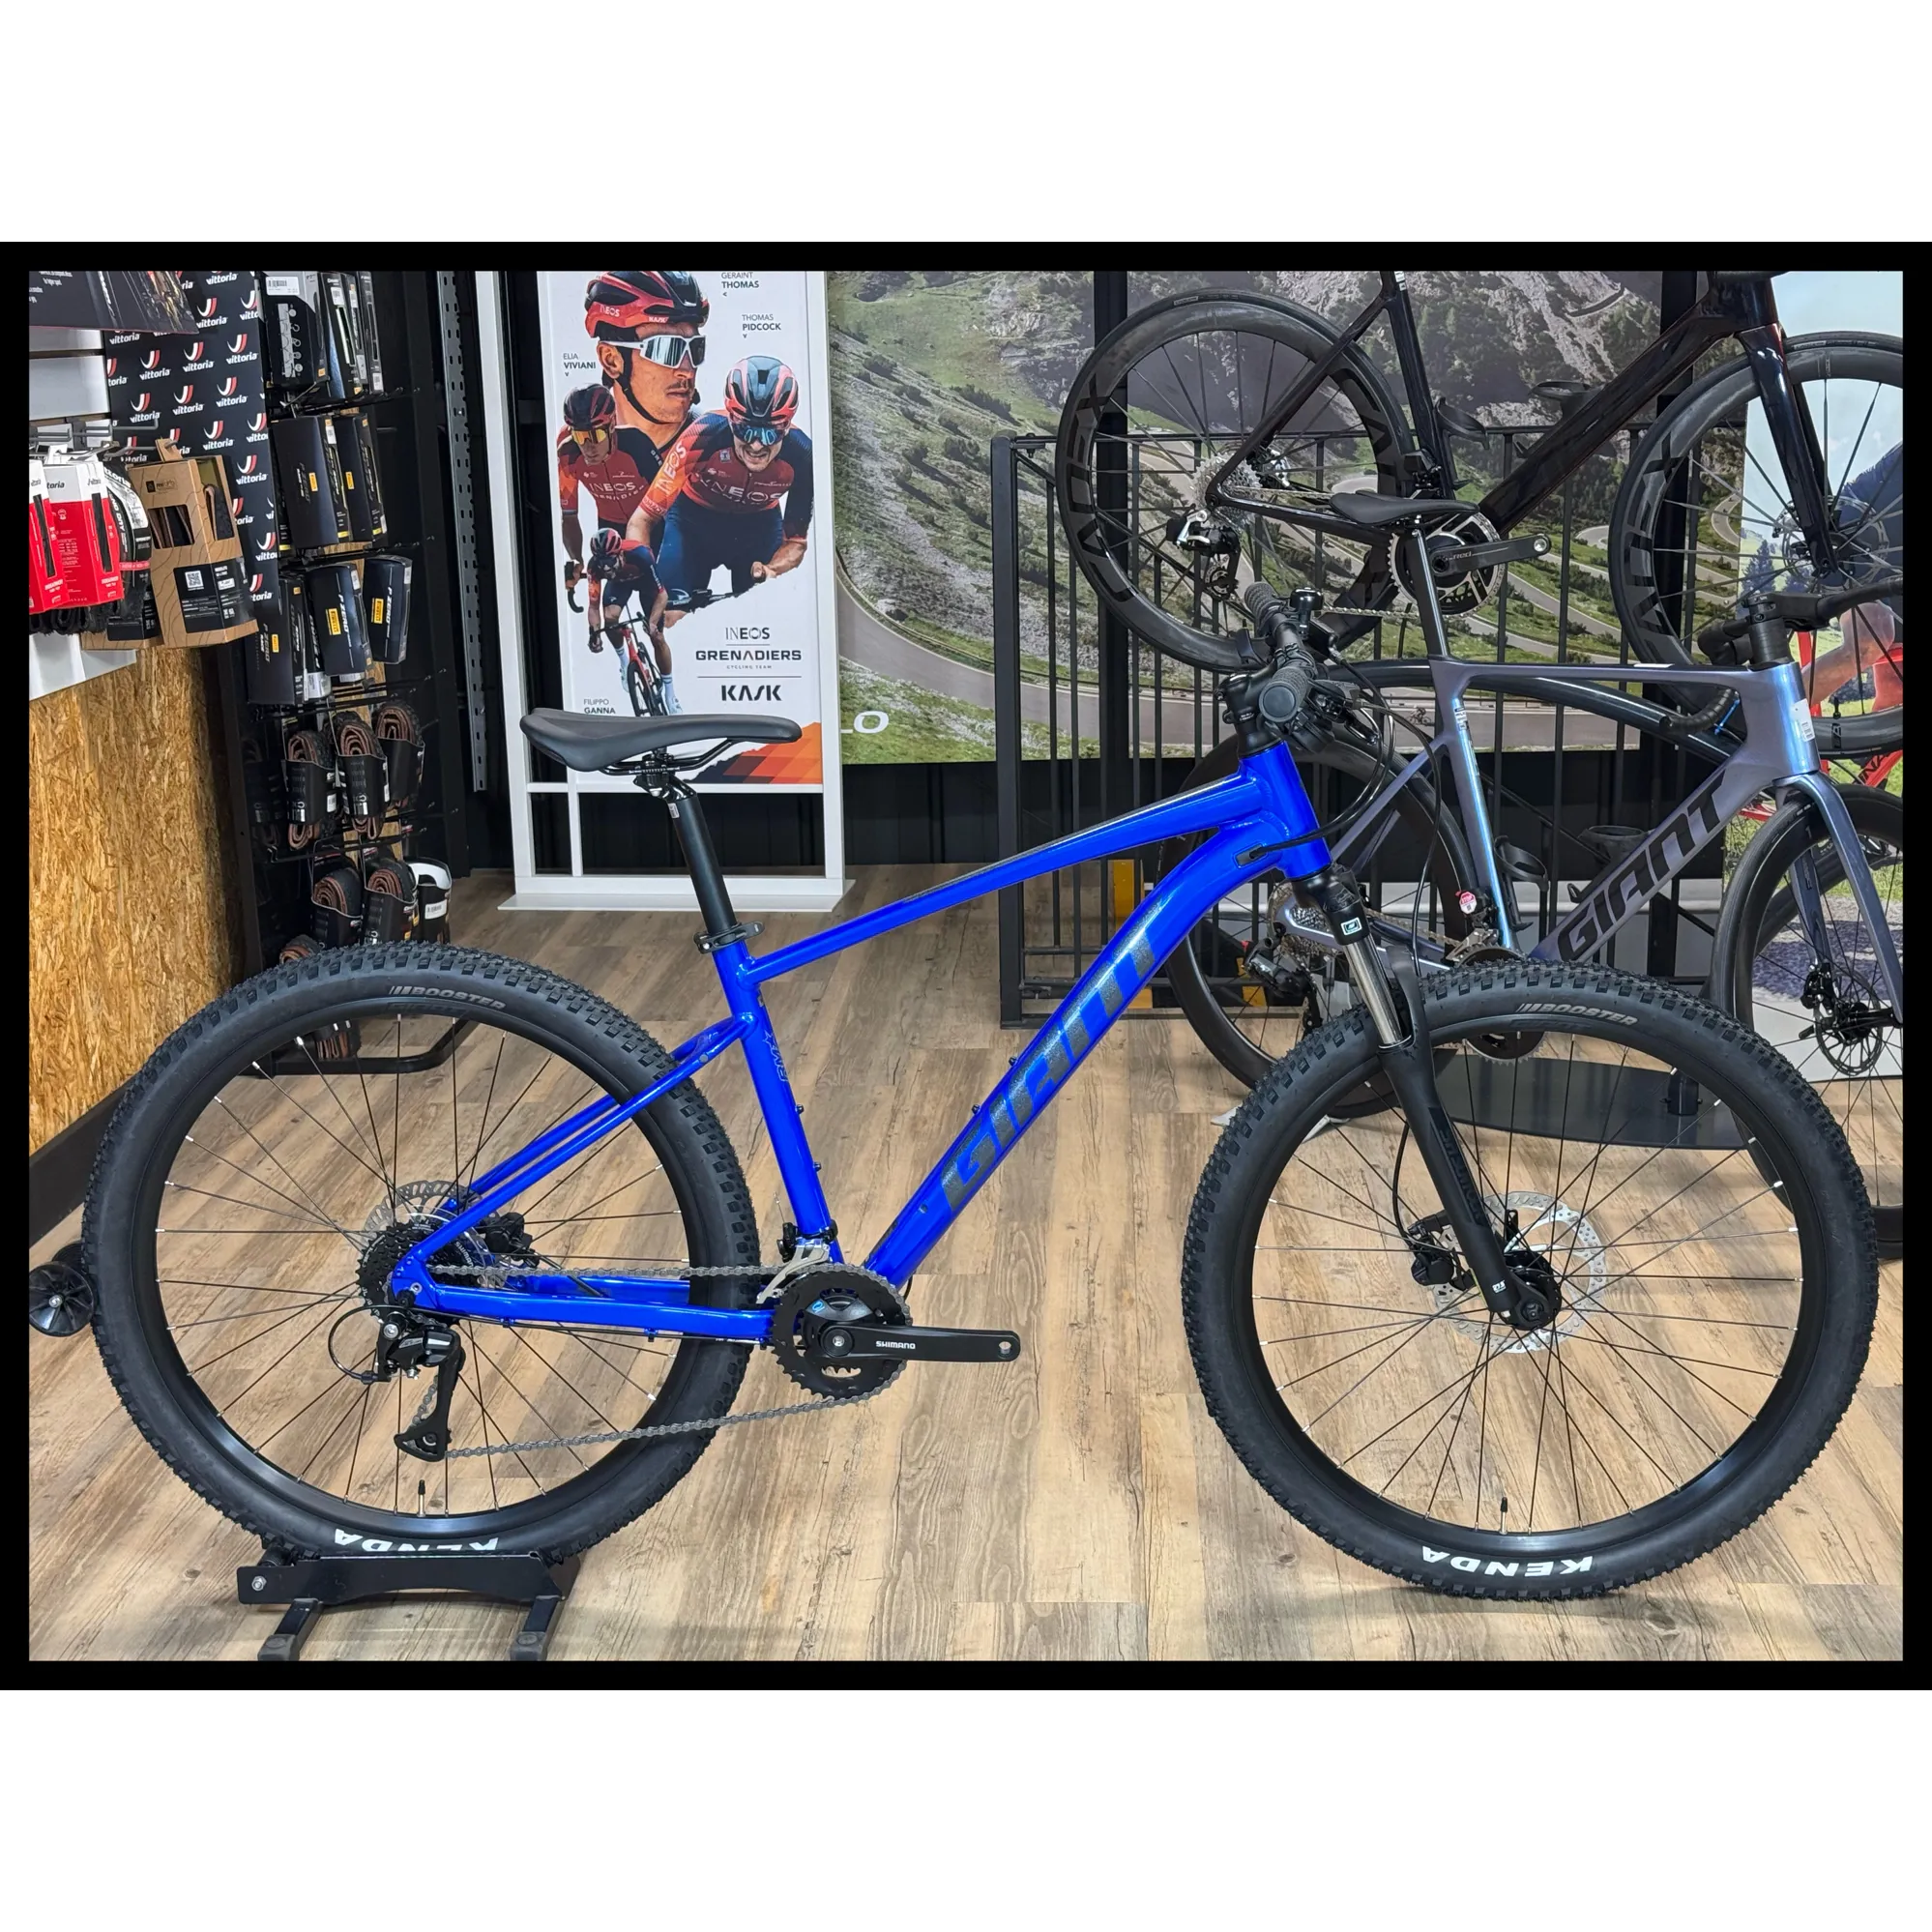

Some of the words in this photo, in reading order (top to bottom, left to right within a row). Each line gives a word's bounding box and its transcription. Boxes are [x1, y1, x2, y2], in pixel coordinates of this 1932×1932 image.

[206, 273, 237, 285] vittoria
[721, 280, 760, 289] THOMAS
[196, 316, 227, 329] vittoria
[743, 323, 781, 332] PIDCOCK
[109, 333, 140, 345] vittoria
[226, 352, 258, 365] vittoria
[183, 360, 214, 372] vittoria
[139, 368, 171, 381] vittoria
[216, 395, 248, 407] vittoria
[172, 402, 204, 415] vittoria
[130, 410, 161, 424] vittoria
[203, 438, 235, 451] vittoria
[656, 441, 687, 495] INEOS
[236, 473, 268, 485] vittoria
[589, 483, 635, 492] INEOS
[725, 627, 771, 640] INEOS
[695, 650, 802, 661] GRENADIERS
[721, 685, 782, 702] KASK
[584, 707, 616, 716] GANNA
[1557, 769, 1725, 962] GIANT
[410, 986, 507, 1010] BOOSTER
[1537, 1004, 1638, 1025] BOOSTER
[941, 889, 1173, 1210] GIANT
[875, 1340, 916, 1350] SHIMANO
[1422, 1545, 1594, 1577] KENDA
